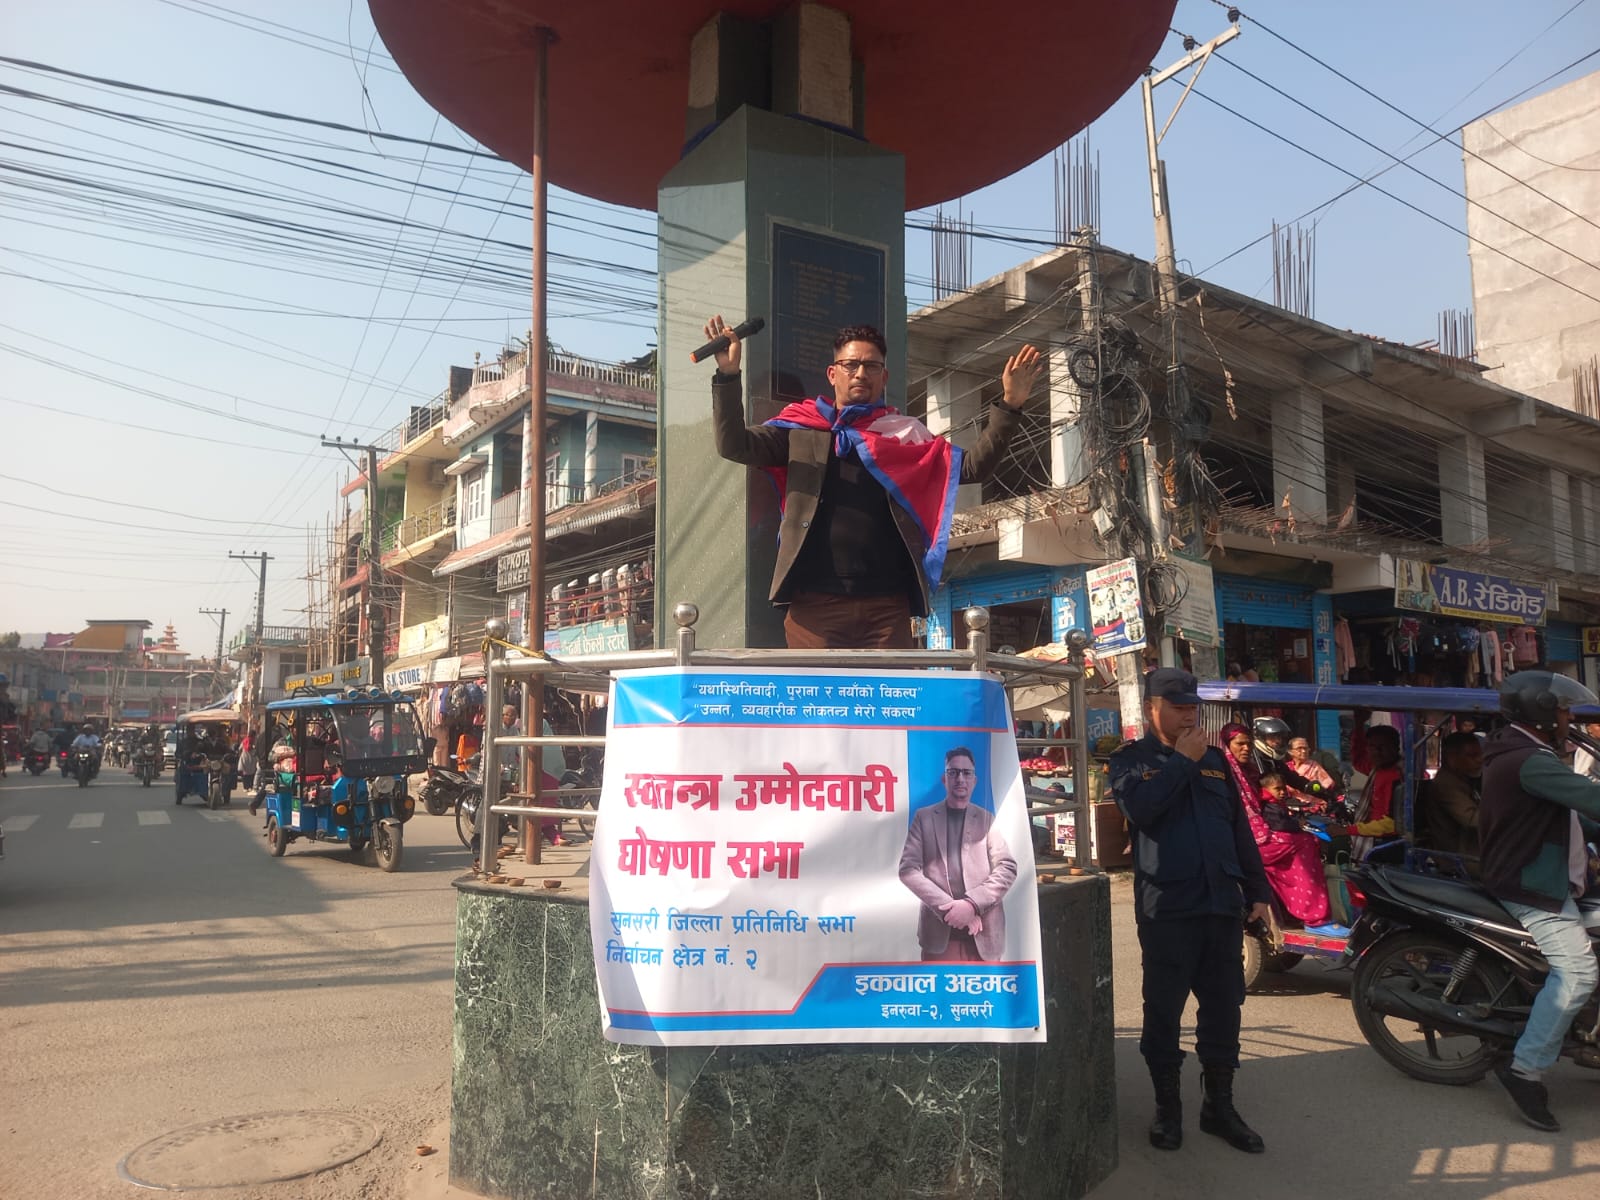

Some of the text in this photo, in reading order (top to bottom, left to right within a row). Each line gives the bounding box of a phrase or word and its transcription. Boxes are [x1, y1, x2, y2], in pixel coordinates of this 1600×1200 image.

[1440, 576, 1544, 615] A.B. रेडिमेड
[399, 668, 421, 684] STORE
[786, 685, 819, 701] पुराना
[824, 686, 833, 699] र
[838, 681, 874, 698] नयाँको
[741, 703, 797, 719] व्यवहारीक
[802, 703, 849, 719] लोकतन्त्र
[854, 703, 875, 719] मेरो
[624, 762, 898, 812] स्वतन्त्र उम्मेदवारी
[618, 826, 804, 880] घोषणा सभा
[610, 907, 856, 935] सुनसरी जिल्ला प्रतिनिधि सभा
[606, 939, 663, 966] निर्वाचन
[672, 943, 706, 969] क्षेत्र
[746, 949, 758, 970] २
[855, 974, 1018, 995] इकवाल अहमद
[950, 1000, 994, 1022] सुनसरी
